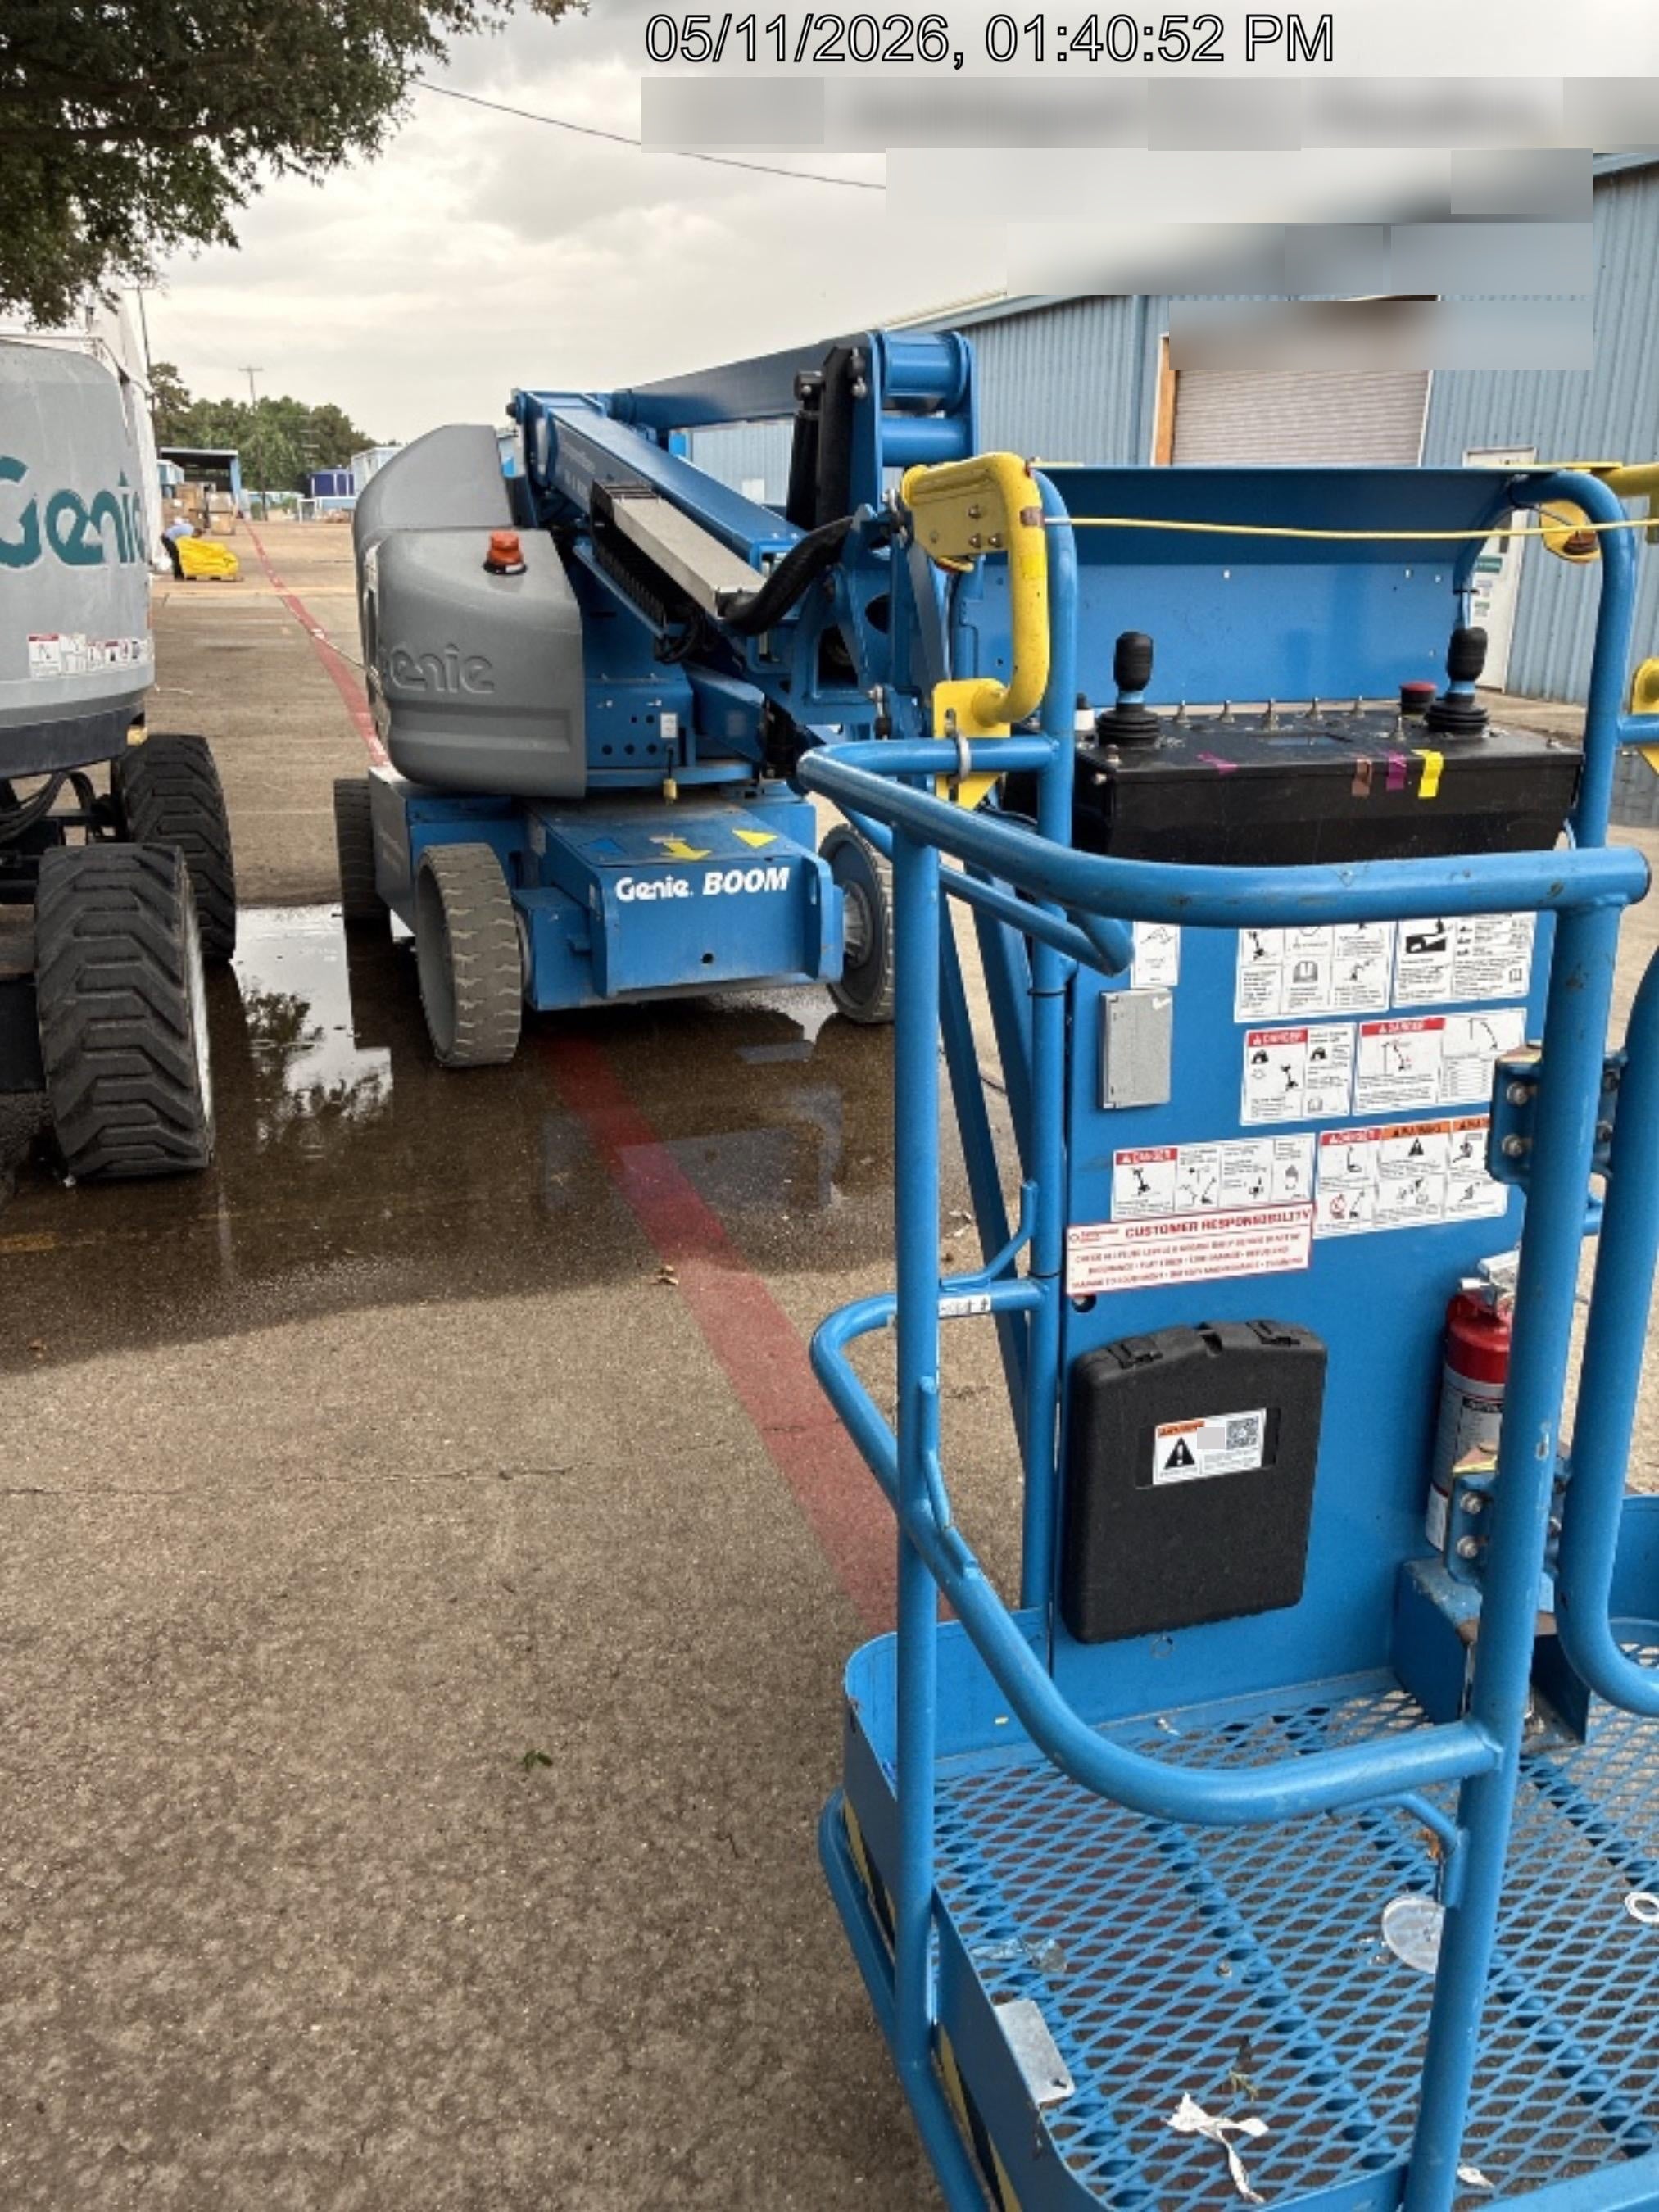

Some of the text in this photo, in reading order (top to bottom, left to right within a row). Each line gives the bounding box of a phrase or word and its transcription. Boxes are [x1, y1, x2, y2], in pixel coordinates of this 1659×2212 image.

[380, 642, 495, 694] enie
[702, 867, 791, 895] BOOM
[1125, 1222, 1198, 1238] CUSTOMER
[1201, 1208, 1309, 1230] RESPONSIBILITY
